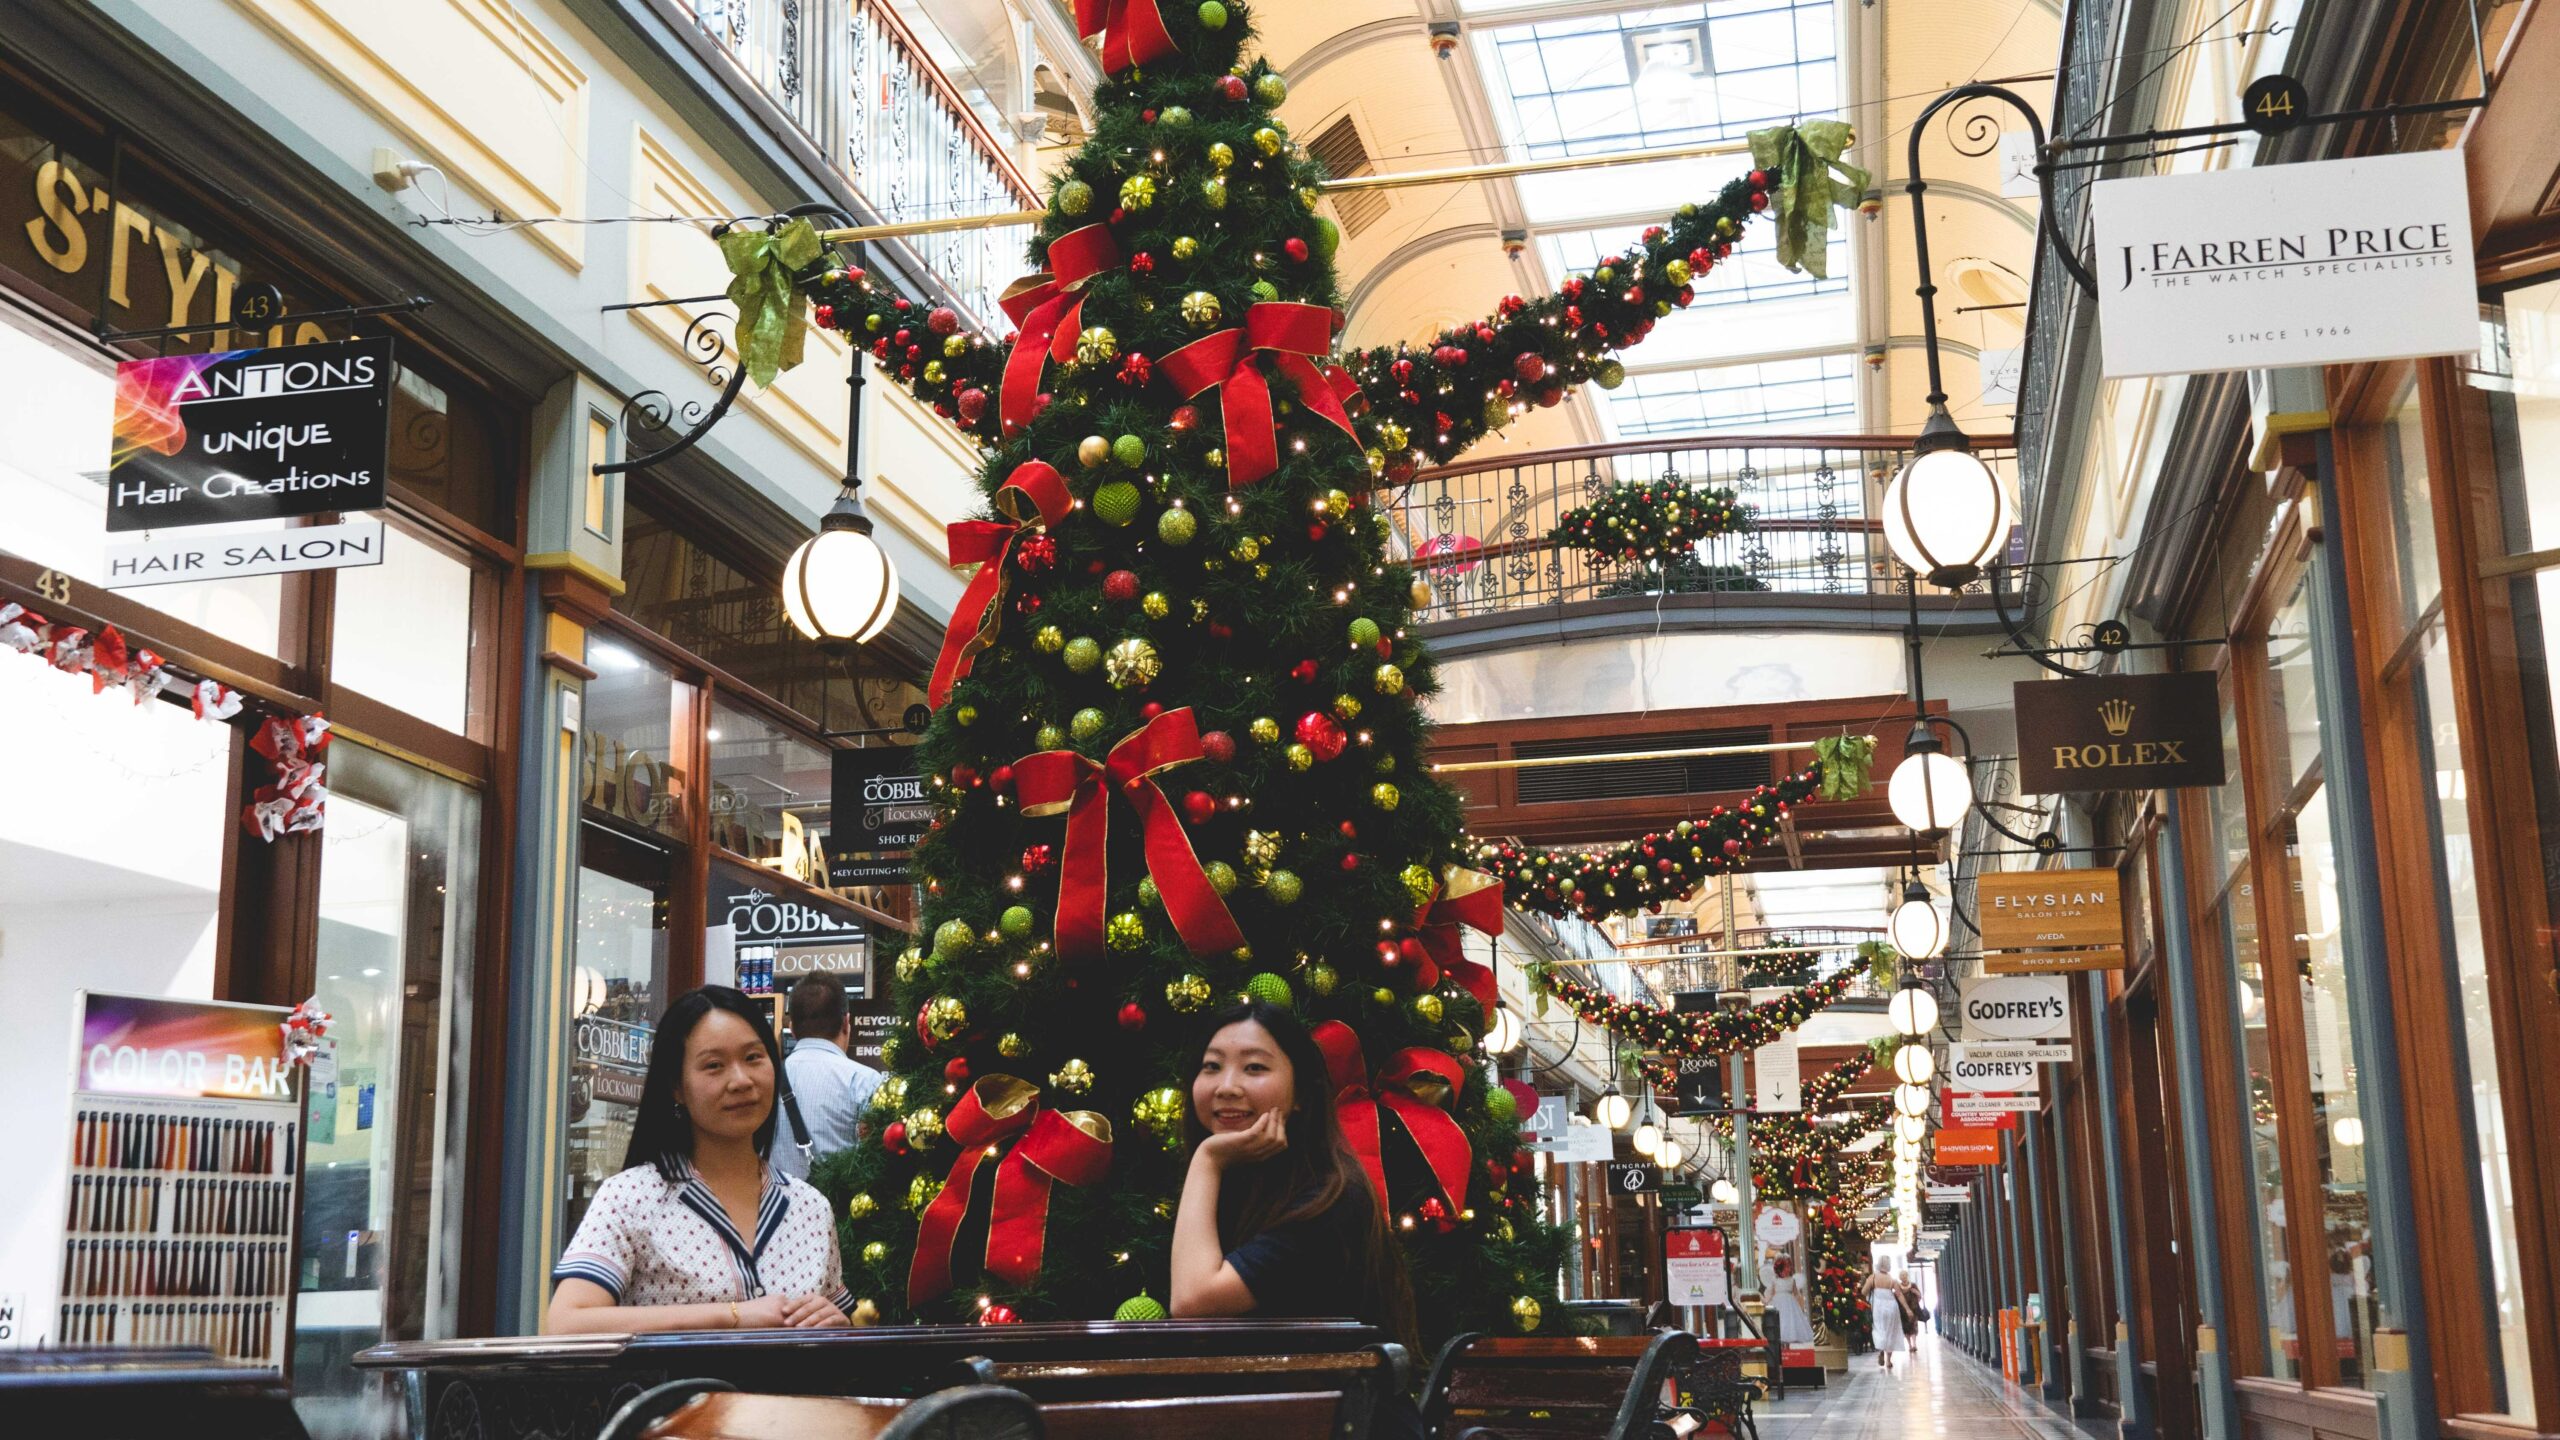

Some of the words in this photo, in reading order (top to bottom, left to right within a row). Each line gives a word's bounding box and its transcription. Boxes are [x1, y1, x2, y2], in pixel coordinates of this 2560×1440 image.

[2256, 90, 2294, 117] 44
[2328, 222, 2450, 258] PRICE
[2151, 276, 2192, 289] THE
[2209, 269, 2286, 283] WATCH
[2303, 254, 2454, 277] SPECIALISTS
[241, 296, 269, 319] 43
[2227, 330, 2288, 344] SINCE
[2304, 325, 2353, 338] 1966
[171, 355, 376, 400] ANTONS
[116, 481, 189, 507] Hair
[111, 551, 205, 576] HAIR
[223, 537, 371, 567] SALON
[36, 569, 71, 606] 43
[2100, 629, 2123, 645] 42
[909, 713, 926, 726] 41
[2053, 741, 2187, 769] ROLEX
[878, 834, 907, 845] SHOE
[2040, 838, 2054, 850] 40
[837, 869, 852, 877] KEY
[853, 867, 891, 876] CUTTING
[1995, 892, 2105, 908] ELYSIAN
[2036, 933, 2065, 941] AVEDA
[2022, 957, 2054, 966] BROW
[1968, 995, 2064, 1020] GODFREY'S
[1969, 1050, 1994, 1059] VACUUM
[1996, 1050, 2025, 1058] CLEANER
[2027, 1048, 2068, 1057] SPECIALISTS
[88, 1043, 207, 1088] COLOR
[224, 1053, 291, 1096] BAR
[1956, 1061, 2033, 1078] GODFREY'S
[1957, 1101, 1977, 1109] VACUUM
